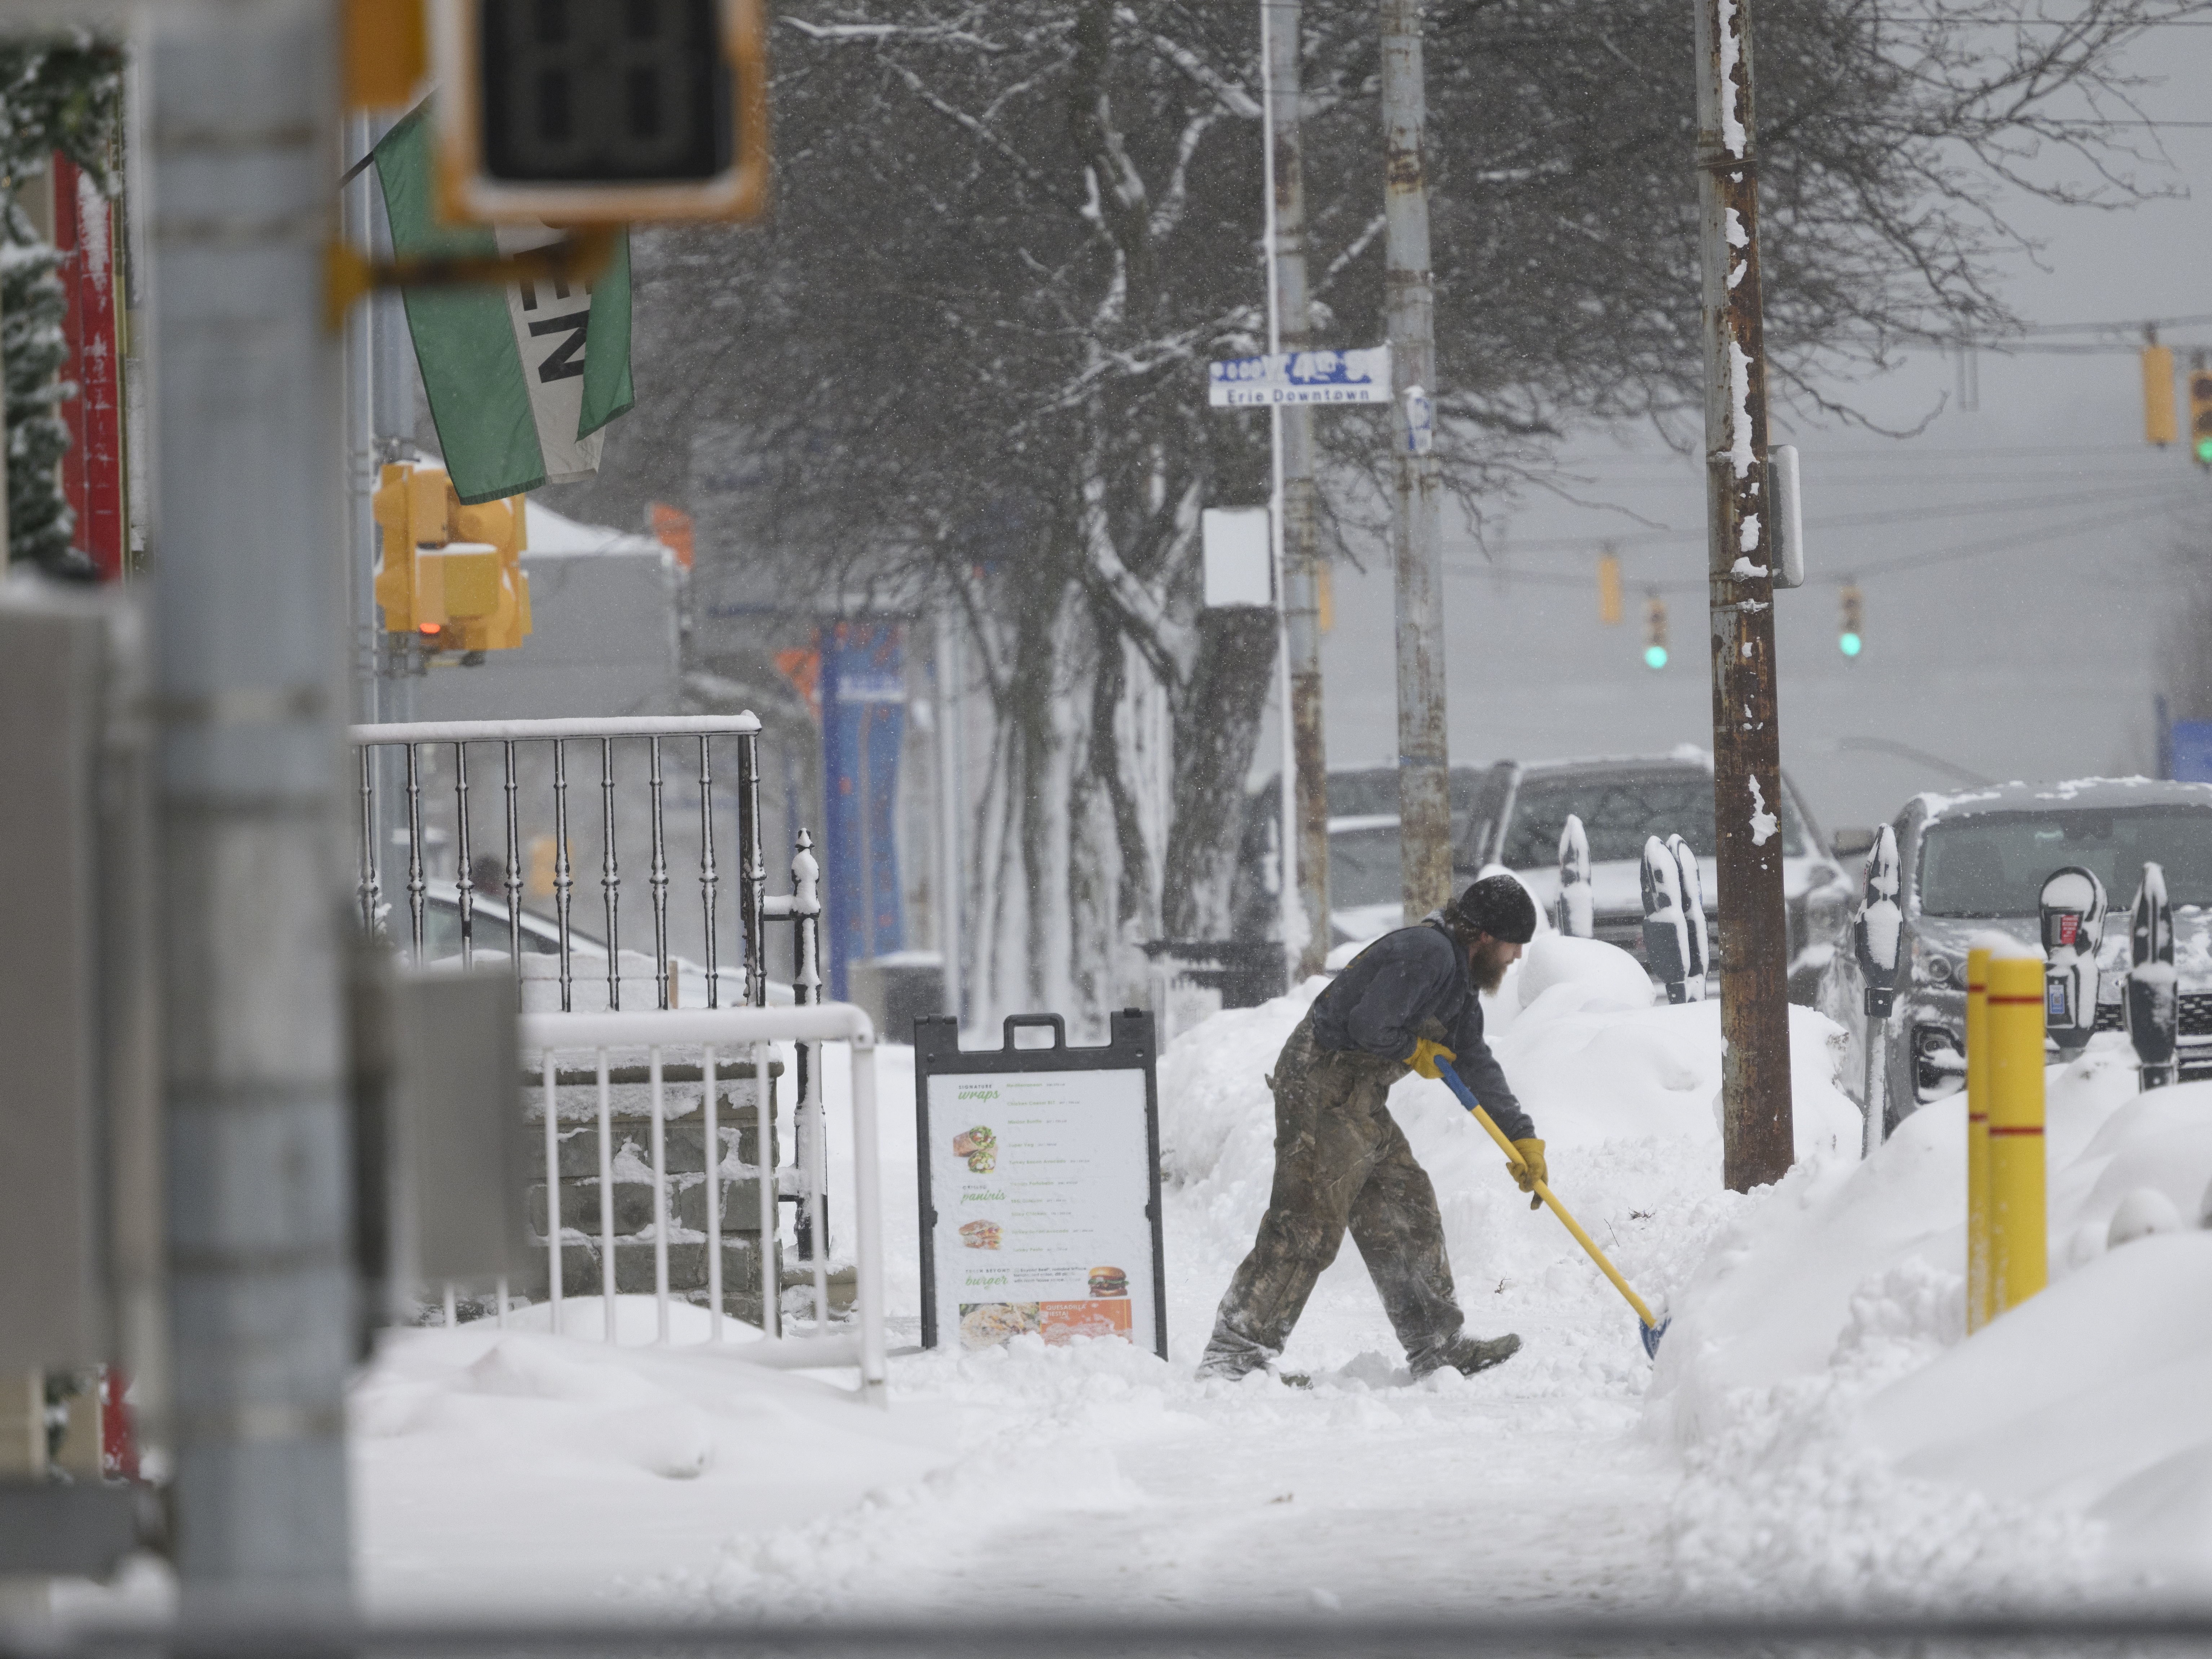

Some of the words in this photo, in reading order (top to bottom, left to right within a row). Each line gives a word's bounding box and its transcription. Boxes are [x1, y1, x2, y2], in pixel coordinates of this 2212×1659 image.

[1227, 389, 1265, 403] Erie
[1273, 388, 1370, 402] Downtown
[958, 1090, 1001, 1103] wraps
[960, 1189, 1005, 1205] paninis
[965, 1275, 1009, 1290] burger
